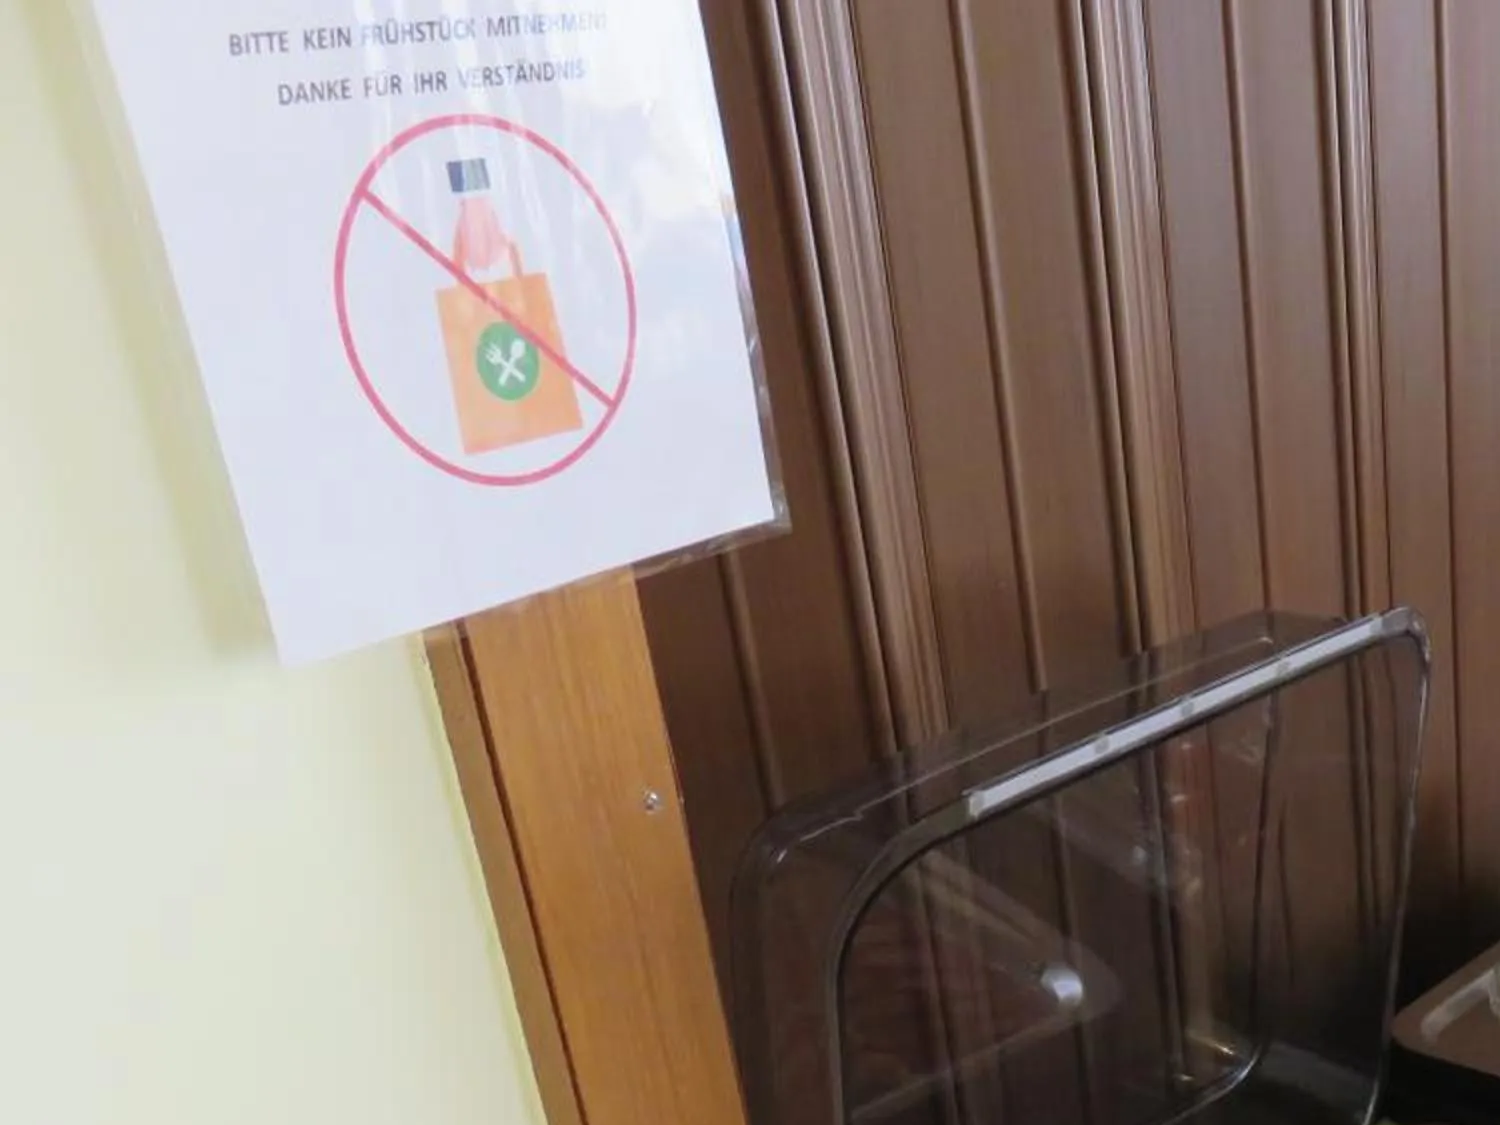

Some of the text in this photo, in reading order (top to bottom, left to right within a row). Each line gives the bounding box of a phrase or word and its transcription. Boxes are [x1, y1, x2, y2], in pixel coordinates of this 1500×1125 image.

[229, 31, 289, 56] BITTE
[303, 26, 352, 50] KEIN
[361, 17, 476, 46] FRÜHSTÜCK
[278, 79, 352, 106] DANKE
[413, 71, 448, 94] IHR
